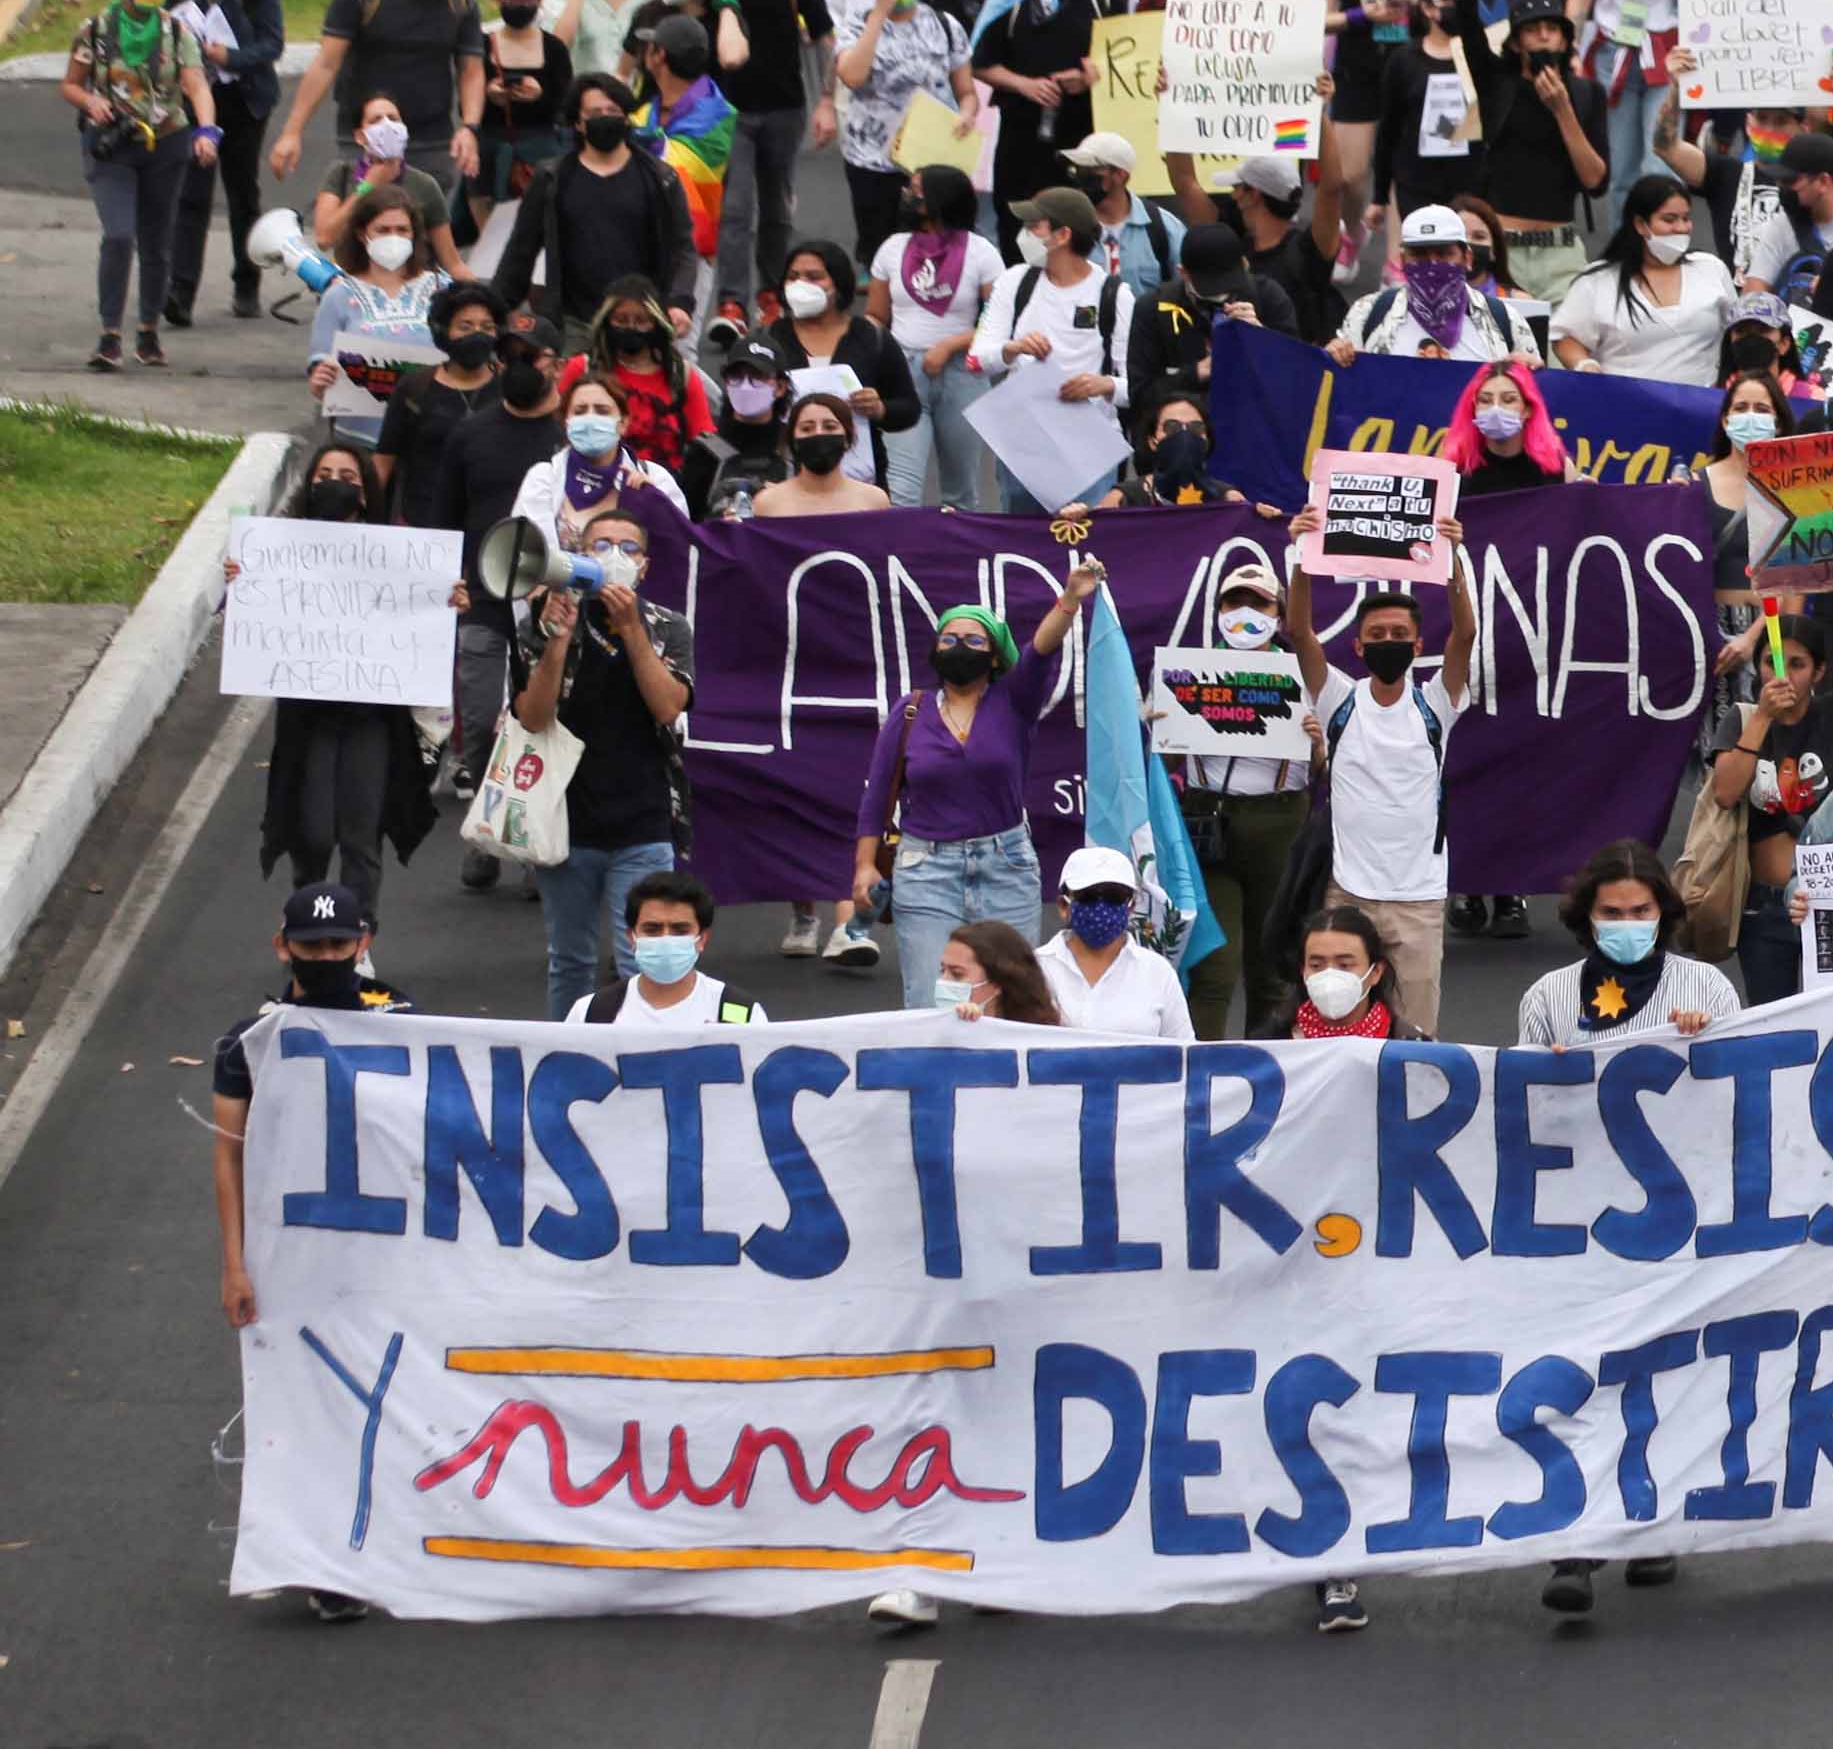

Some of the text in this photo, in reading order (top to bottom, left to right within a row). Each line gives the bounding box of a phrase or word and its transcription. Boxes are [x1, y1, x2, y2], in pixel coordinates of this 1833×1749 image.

[1388, 496, 1402, 510] a
[239, 527, 388, 573] Guatemala
[1201, 686, 1233, 704] SER
[1237, 689, 1281, 705] COMO
[1201, 705, 1256, 722] SOMOS
[1802, 853, 1820, 866] NO
[312, 894, 336, 920] NY
[299, 1324, 404, 1551] Y
[414, 1397, 1028, 1513] nunca
